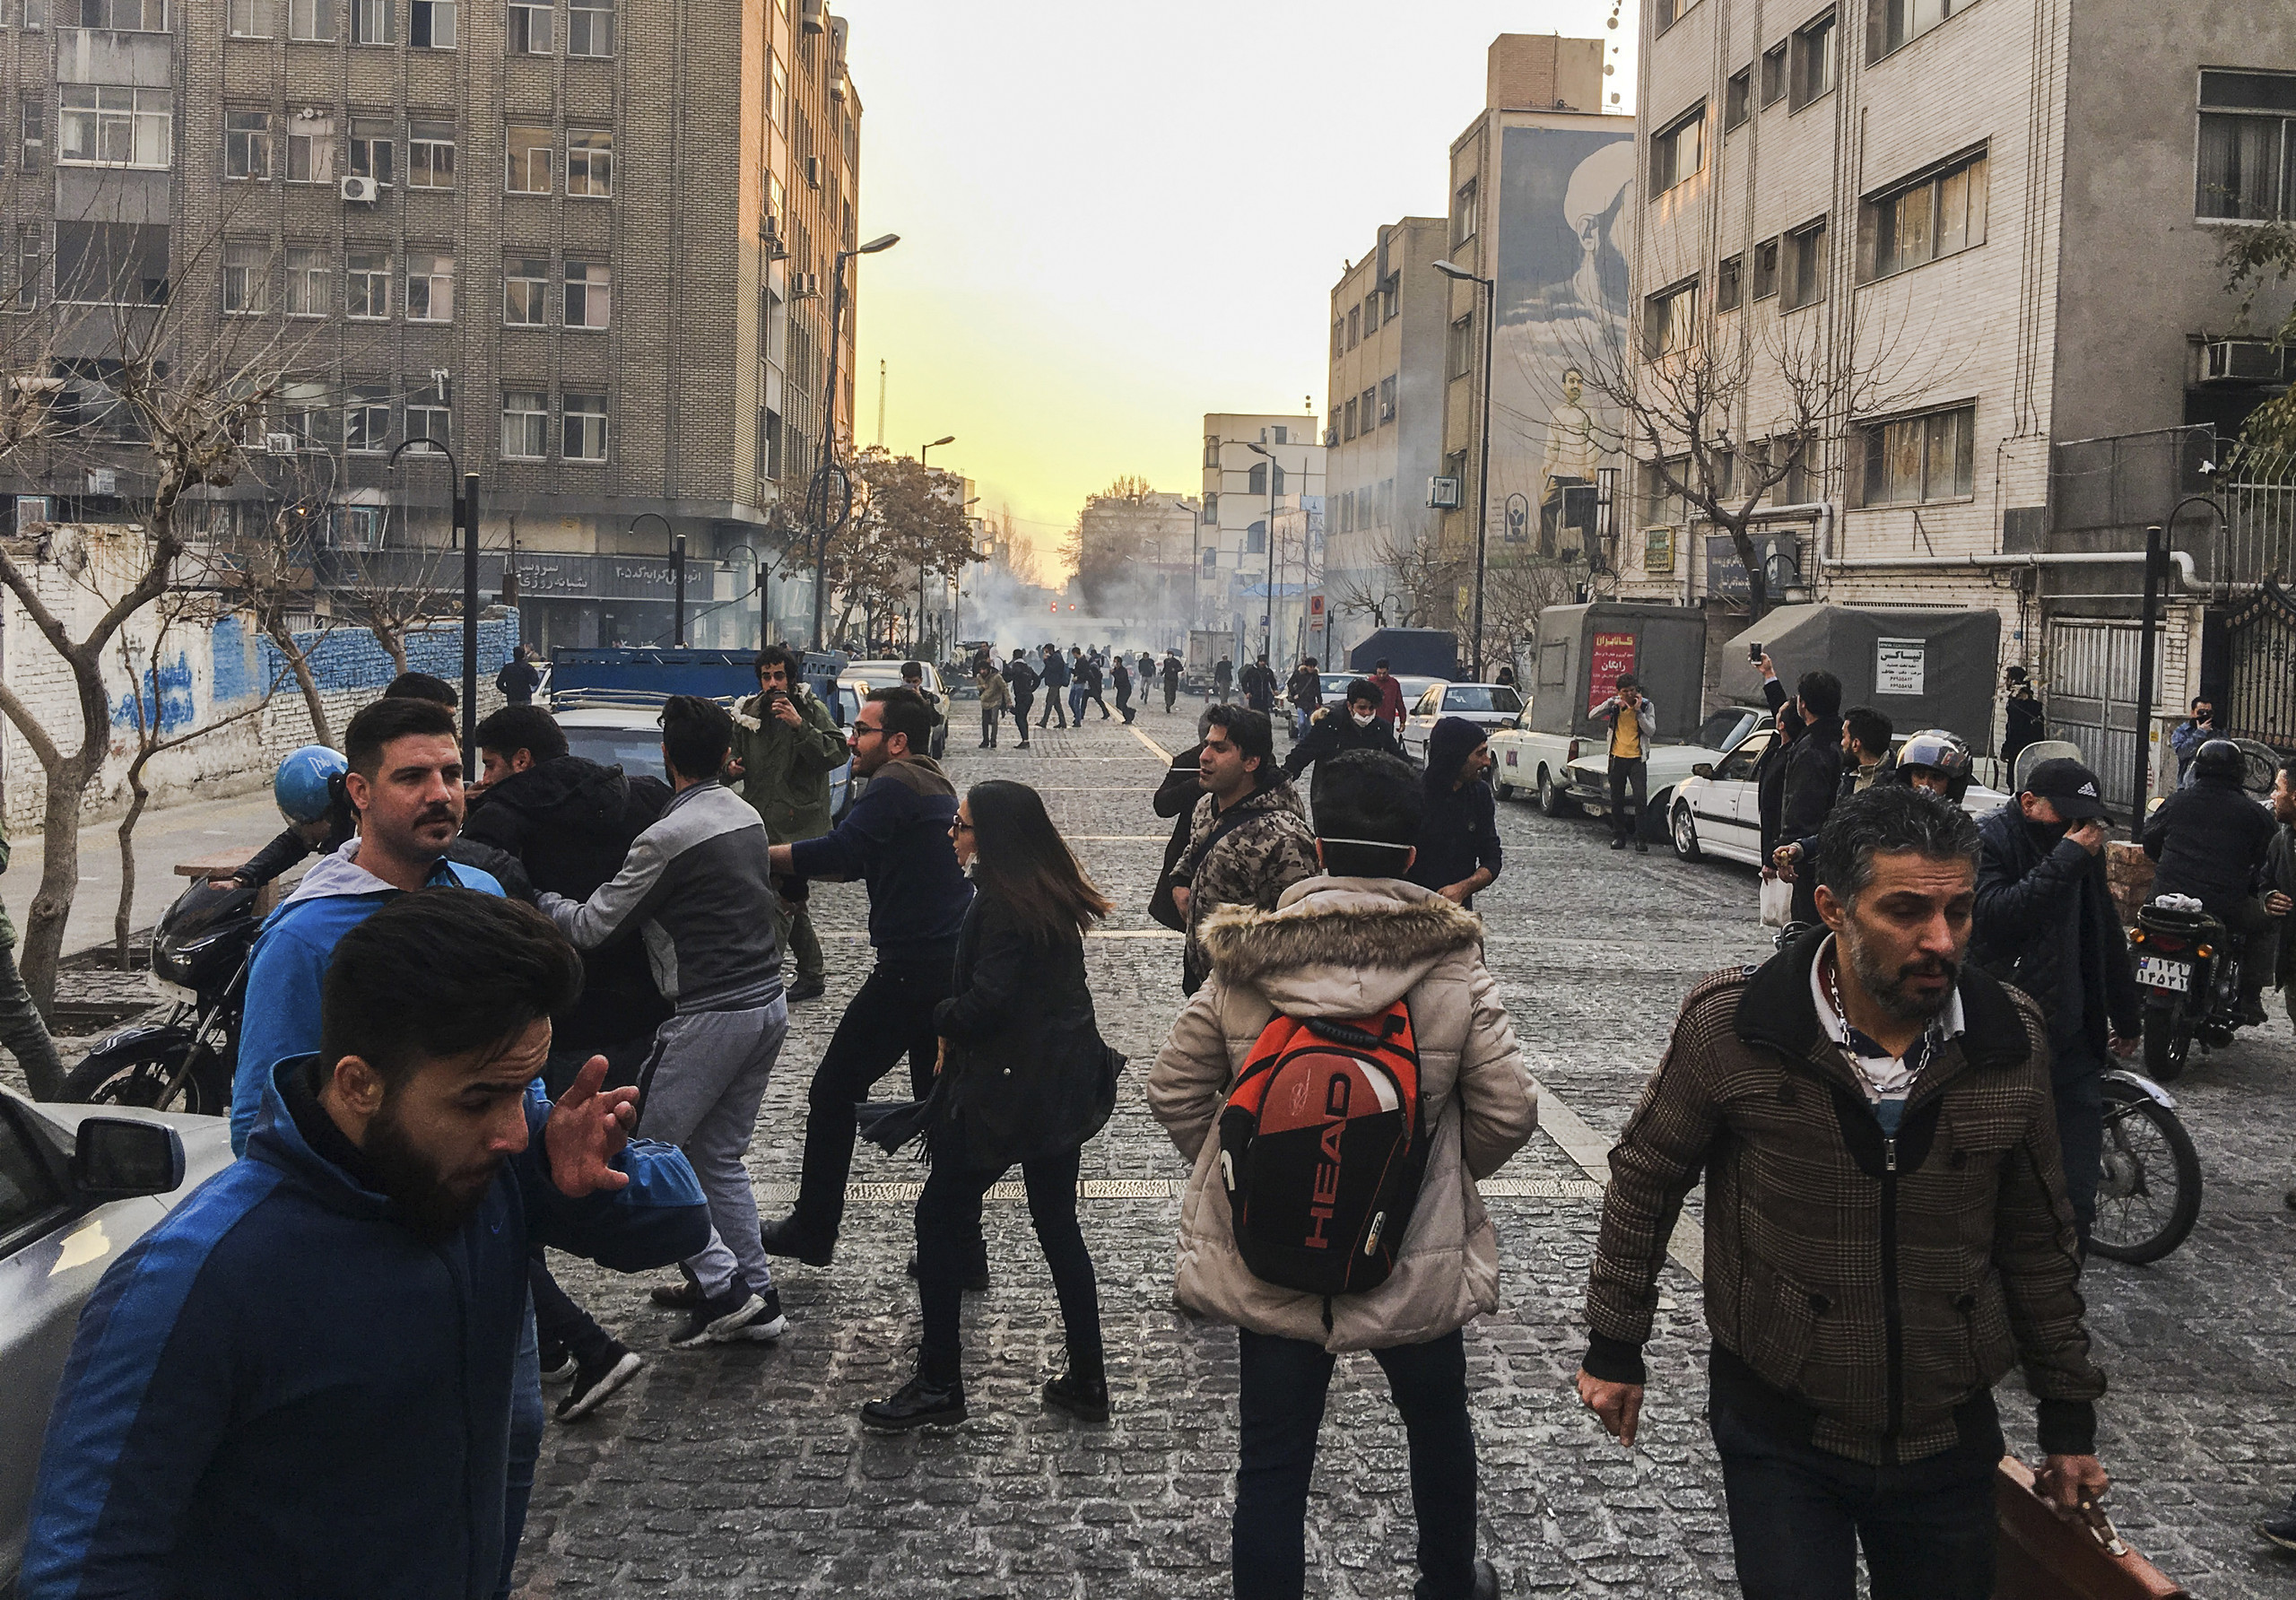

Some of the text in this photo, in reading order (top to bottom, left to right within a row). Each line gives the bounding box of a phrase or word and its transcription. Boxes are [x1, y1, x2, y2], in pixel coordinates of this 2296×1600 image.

[632, 565, 647, 578] کد
[643, 568, 669, 584] کرایه
[518, 575, 587, 591] شبانه روزی
[1601, 660, 1626, 672] رایگان
[1305, 1072, 1352, 1249] HEAD
